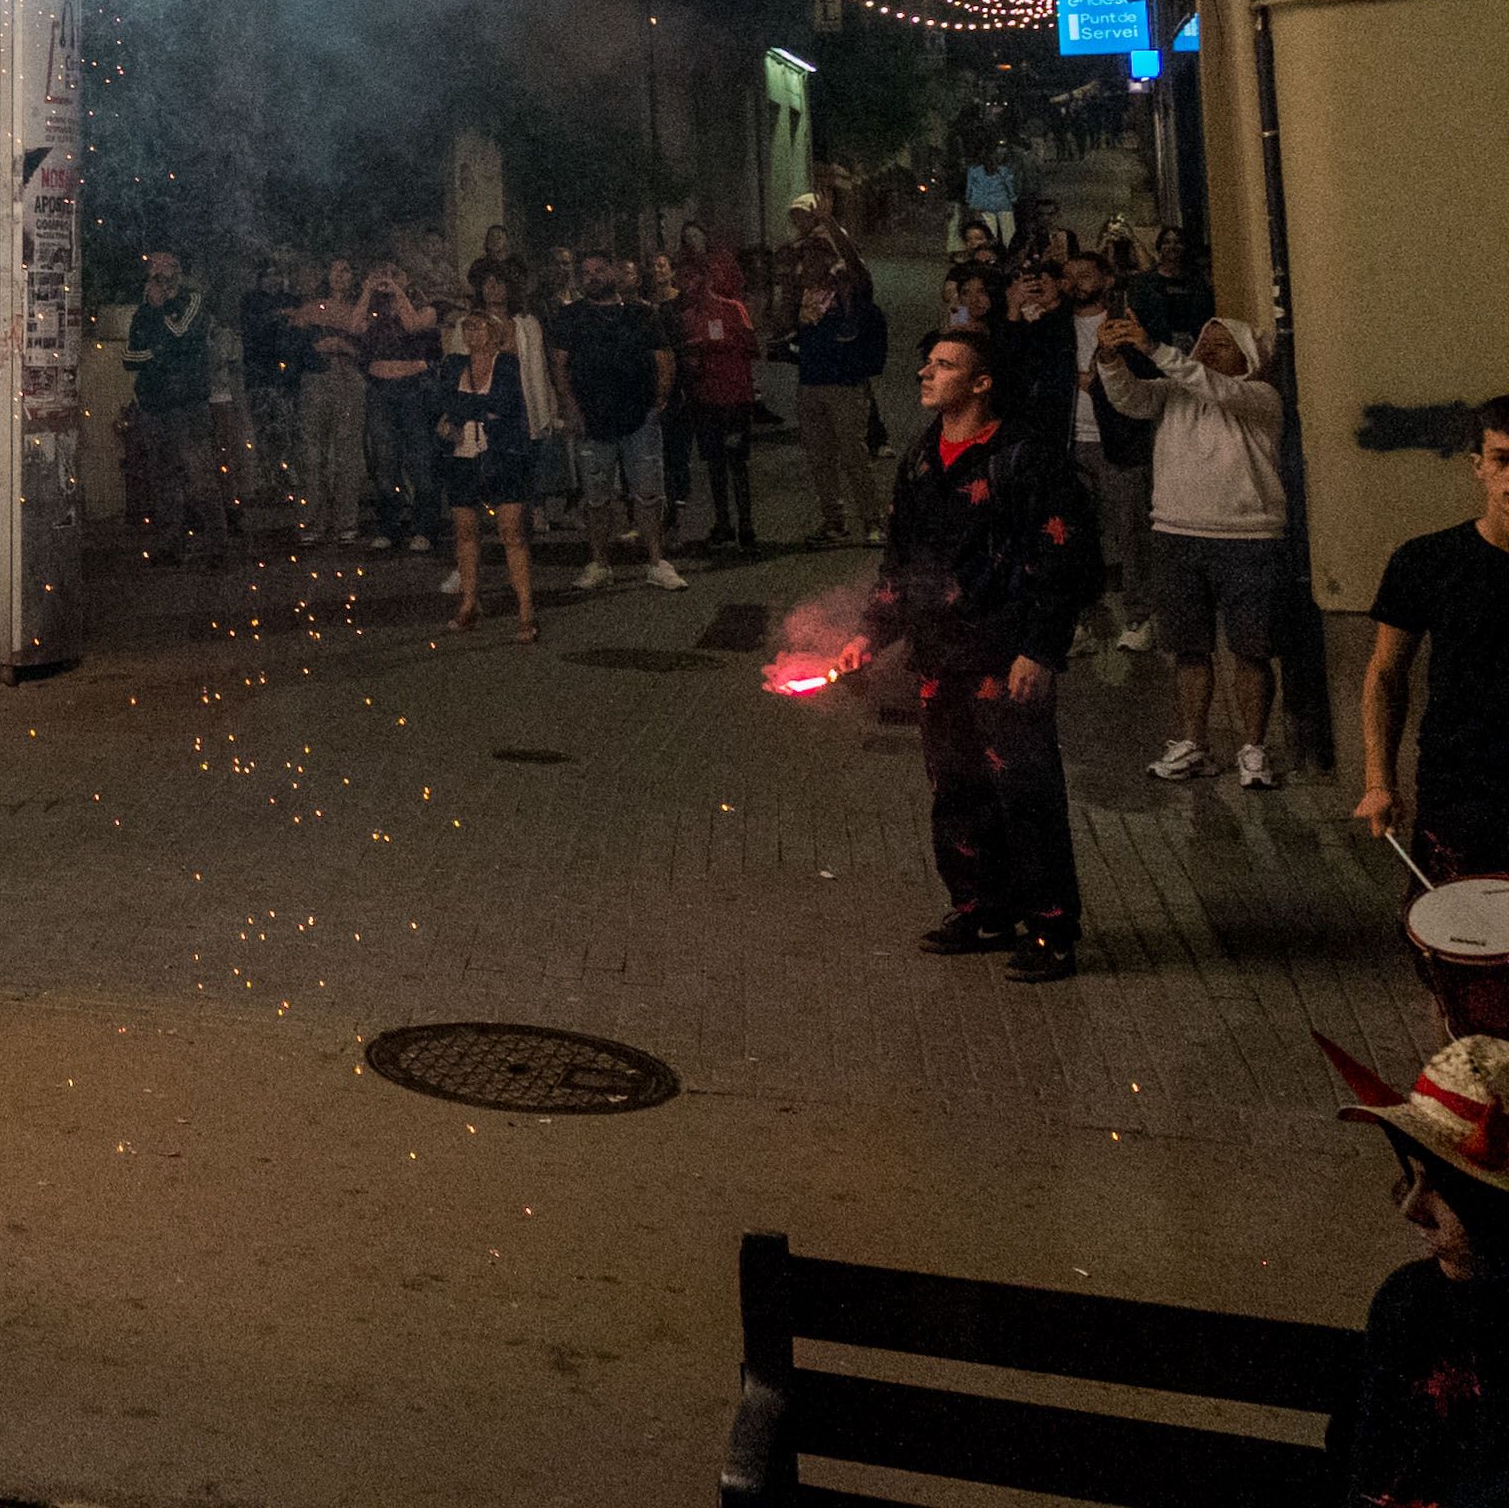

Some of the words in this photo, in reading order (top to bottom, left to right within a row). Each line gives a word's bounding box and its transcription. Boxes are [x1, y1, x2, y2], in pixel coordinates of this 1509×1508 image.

[1080, 12, 1116, 24] Punt
[1117, 12, 1137, 22] de
[1081, 25, 1139, 40] Servei
